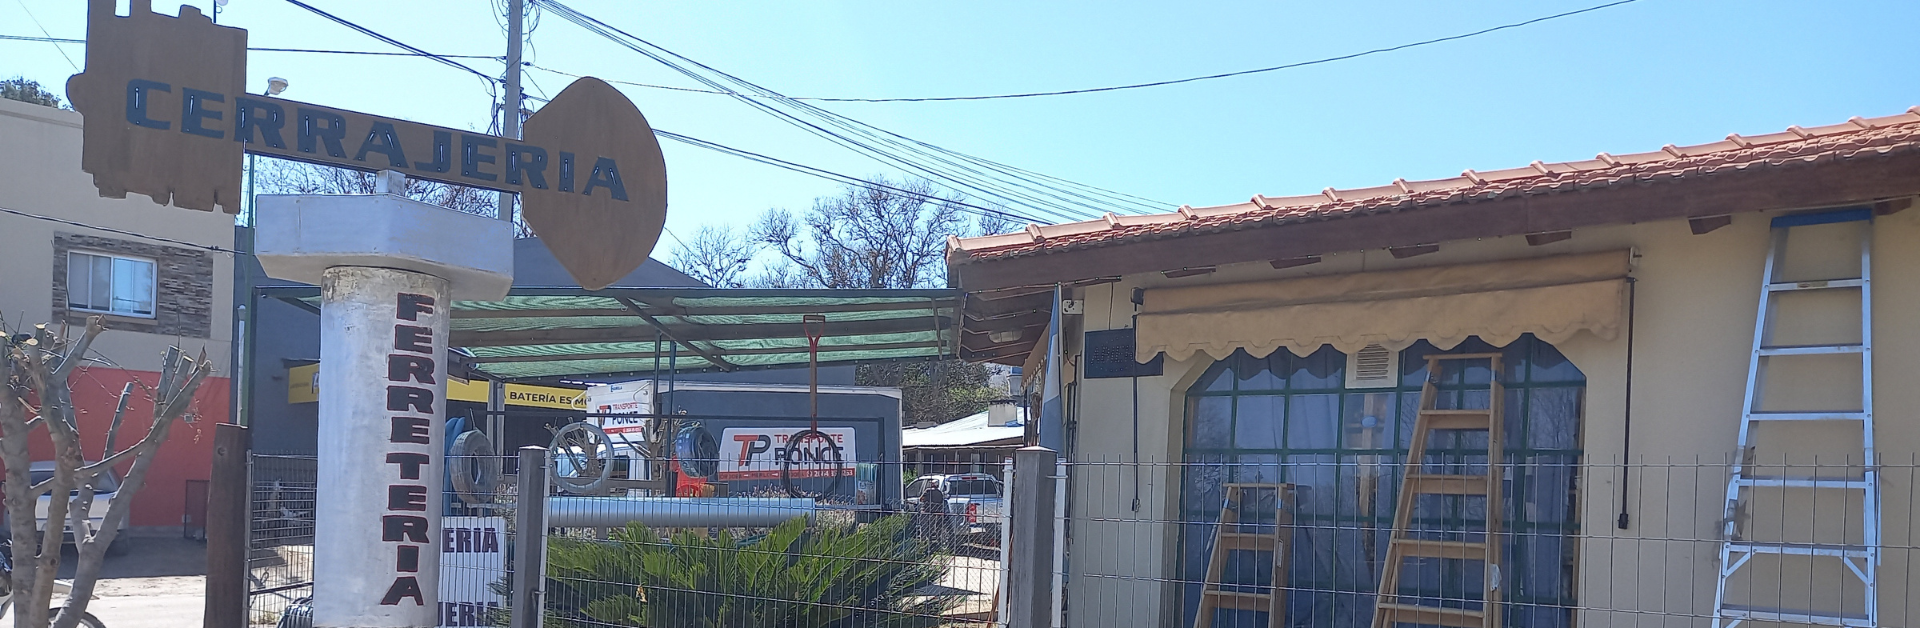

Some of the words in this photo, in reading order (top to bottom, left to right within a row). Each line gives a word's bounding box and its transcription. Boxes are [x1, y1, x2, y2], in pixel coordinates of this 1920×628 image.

[125, 77, 630, 202] CERRAJERIA
[509, 391, 556, 404] BATERÍA
[559, 396, 572, 405] ES
[612, 402, 638, 410] TRANSPORTE
[612, 411, 638, 425] PONCE
[774, 433, 844, 444] TRNSPOTE
[379, 291, 437, 606] FERRETERIA
